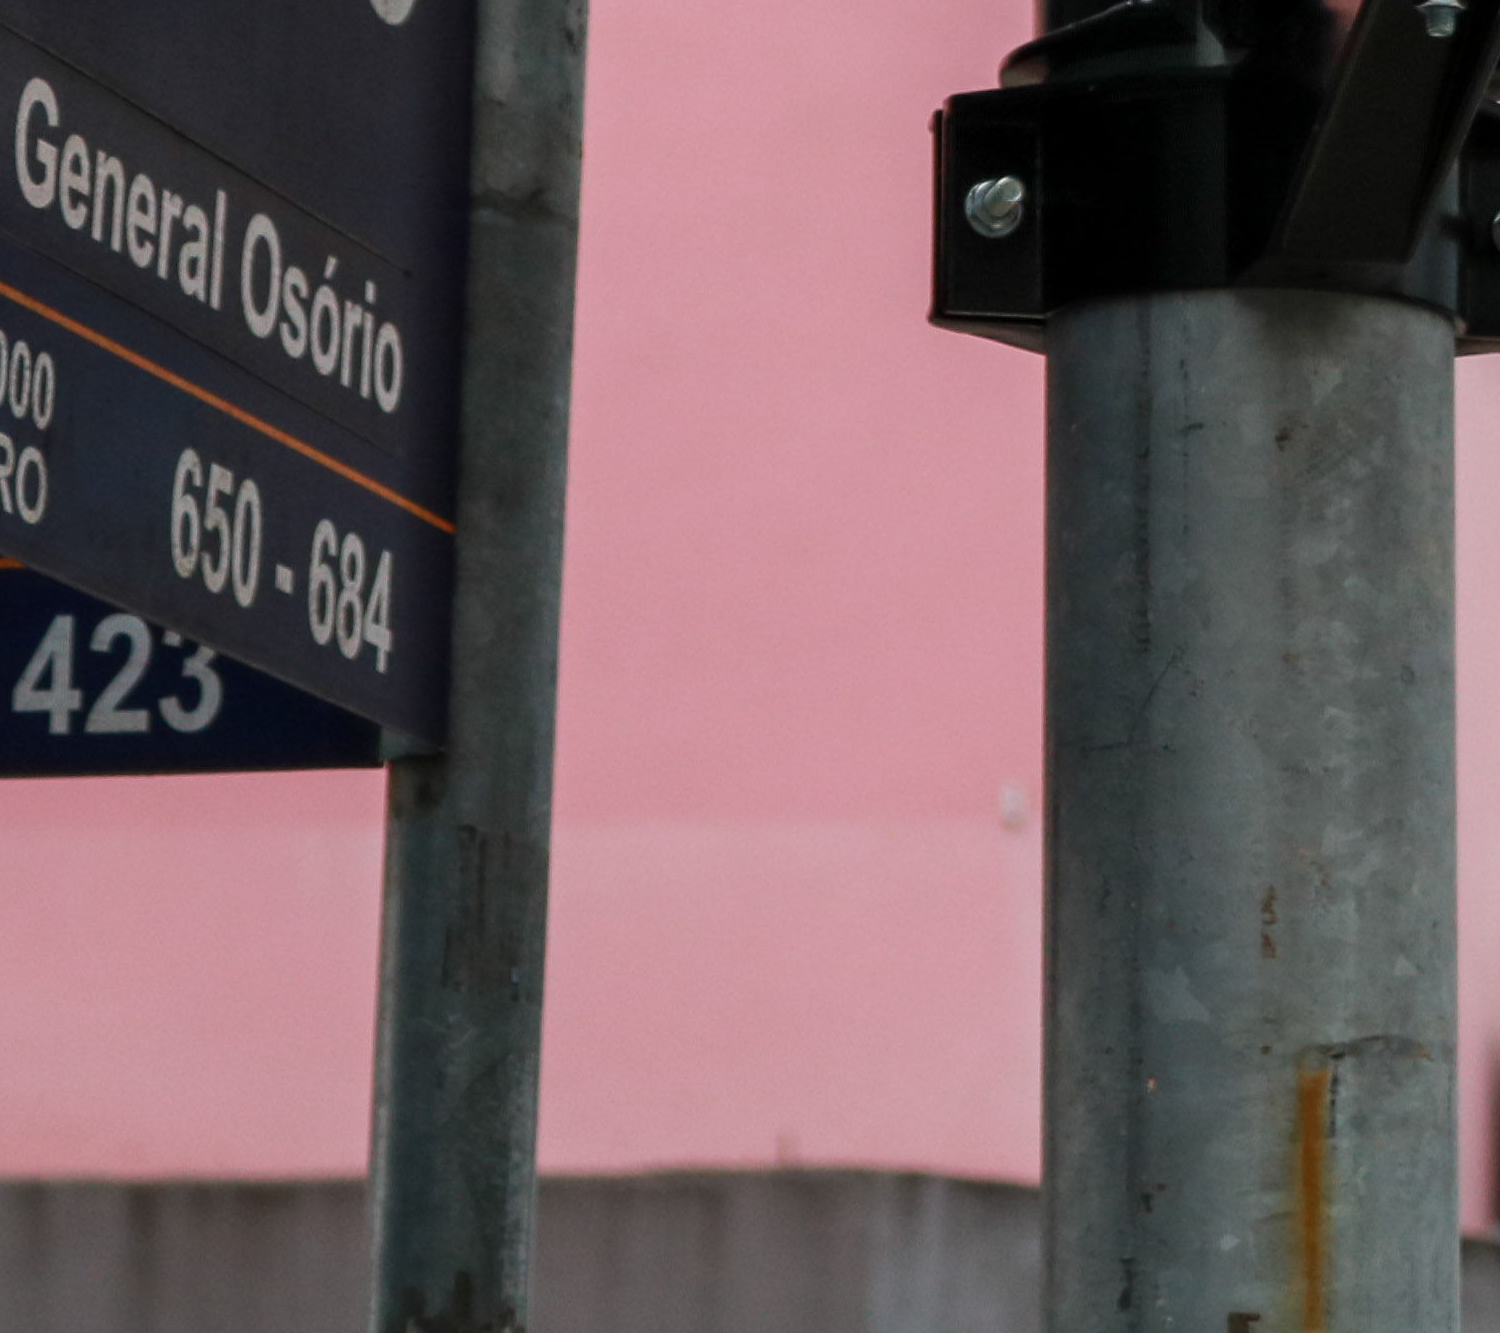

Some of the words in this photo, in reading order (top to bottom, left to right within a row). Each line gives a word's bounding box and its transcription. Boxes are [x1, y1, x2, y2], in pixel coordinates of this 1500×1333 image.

[15, 77, 228, 311] General
[241, 212, 404, 414] Osório
[14, 615, 223, 733] 423
[171, 448, 263, 608] 650
[276, 564, 293, 594] -
[308, 519, 393, 674] 684
